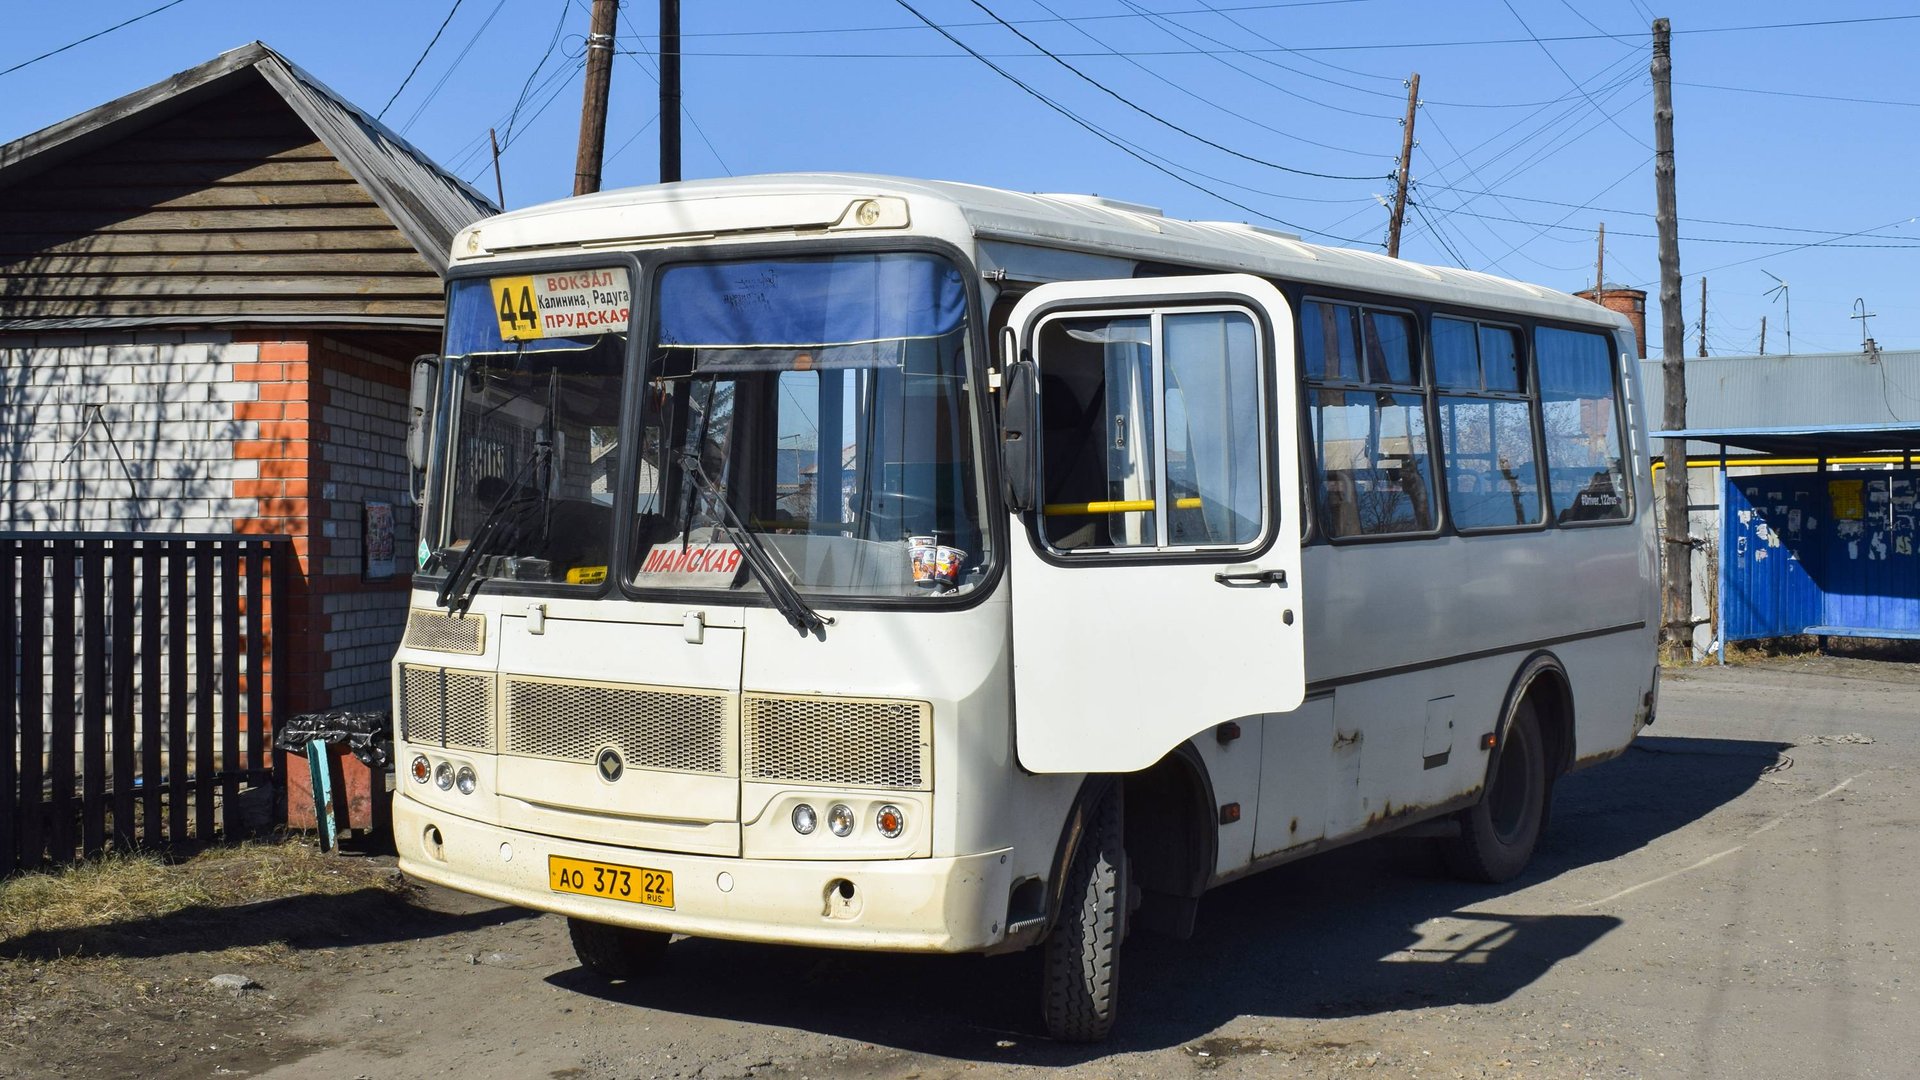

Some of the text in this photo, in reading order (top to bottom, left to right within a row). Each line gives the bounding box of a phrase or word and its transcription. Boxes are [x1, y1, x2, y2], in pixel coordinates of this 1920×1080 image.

[547, 272, 613, 292] ВОКЗАЛ
[500, 285, 537, 331] 44
[537, 289, 629, 310] Калинина, Радуга
[545, 308, 630, 329] ПРУДСКАЯ
[644, 546, 741, 573] МАЙСКАЯ
[593, 867, 631, 896] 373
[644, 873, 665, 894] 22
[647, 894, 663, 903] RUS
